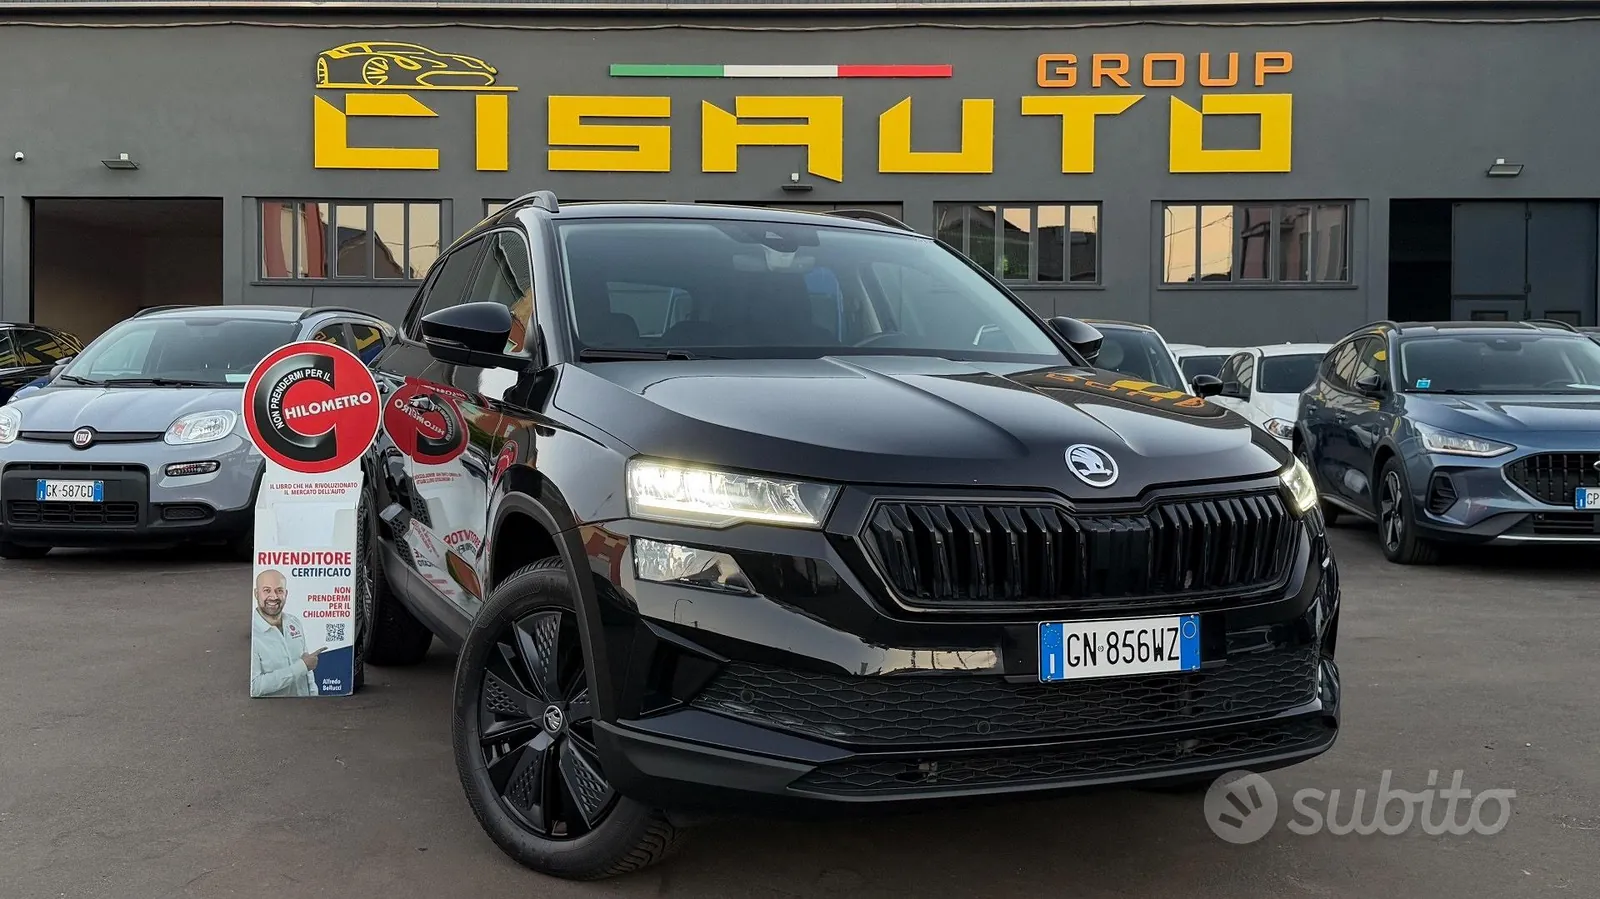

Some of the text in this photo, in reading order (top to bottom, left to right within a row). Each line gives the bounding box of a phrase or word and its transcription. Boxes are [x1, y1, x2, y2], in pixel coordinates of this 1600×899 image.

[1036, 51, 1293, 88] GROUP
[314, 93, 1293, 182] CISAUTO
[270, 369, 331, 430] NON PRENDERMI PER IL
[284, 392, 372, 420] HILOMETRO
[257, 551, 352, 565] RIVENDITORE
[291, 567, 352, 577] CERTIFICATO
[334, 586, 351, 594] NON
[307, 594, 351, 602] PRENDERMI
[328, 602, 351, 610] PER IL
[303, 610, 351, 618] CHILOMETRO
